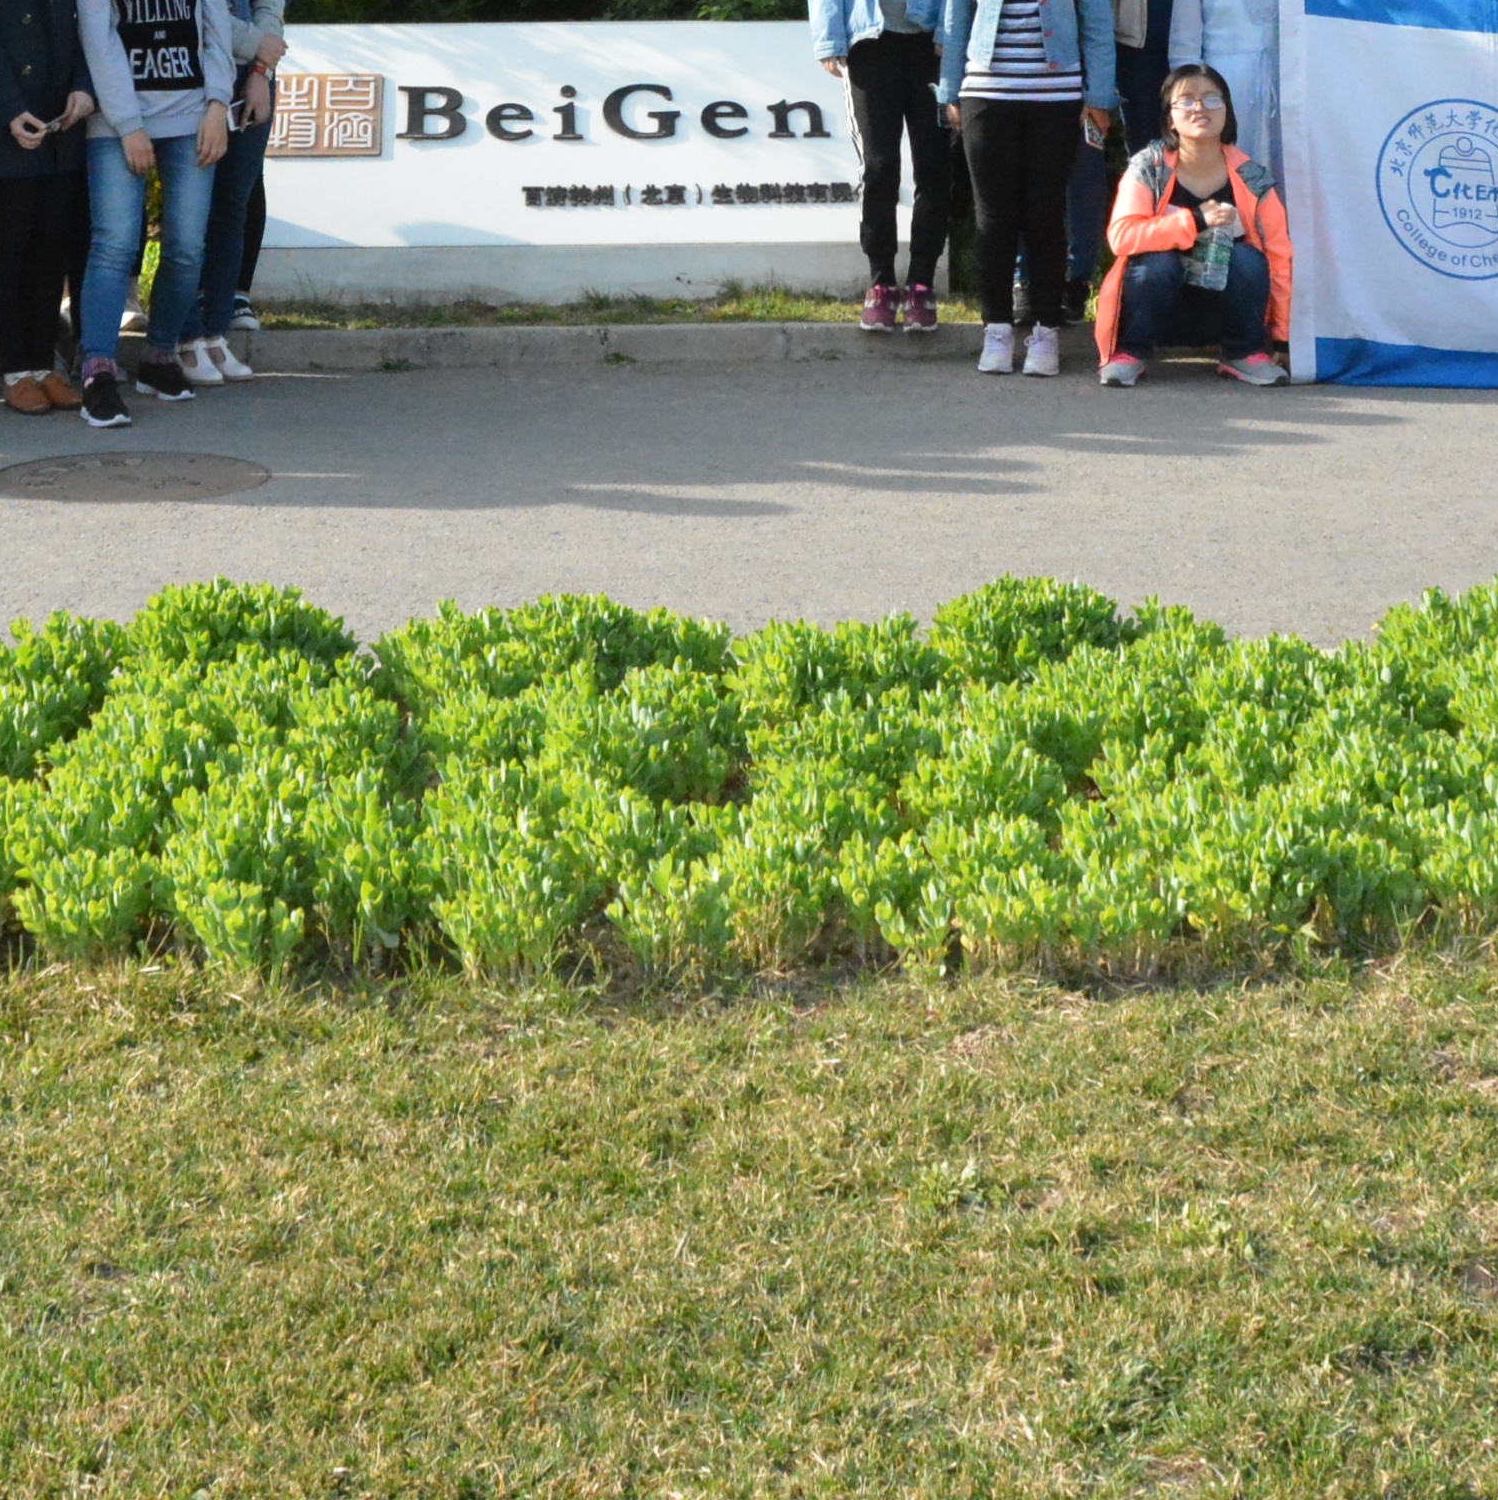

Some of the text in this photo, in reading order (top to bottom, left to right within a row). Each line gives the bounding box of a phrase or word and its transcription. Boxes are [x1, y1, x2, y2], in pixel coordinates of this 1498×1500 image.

[130, 47, 195, 79] EAGER
[1453, 207, 1482, 220] 1912
[1397, 209, 1448, 261] College
[1451, 255, 1467, 267] of
